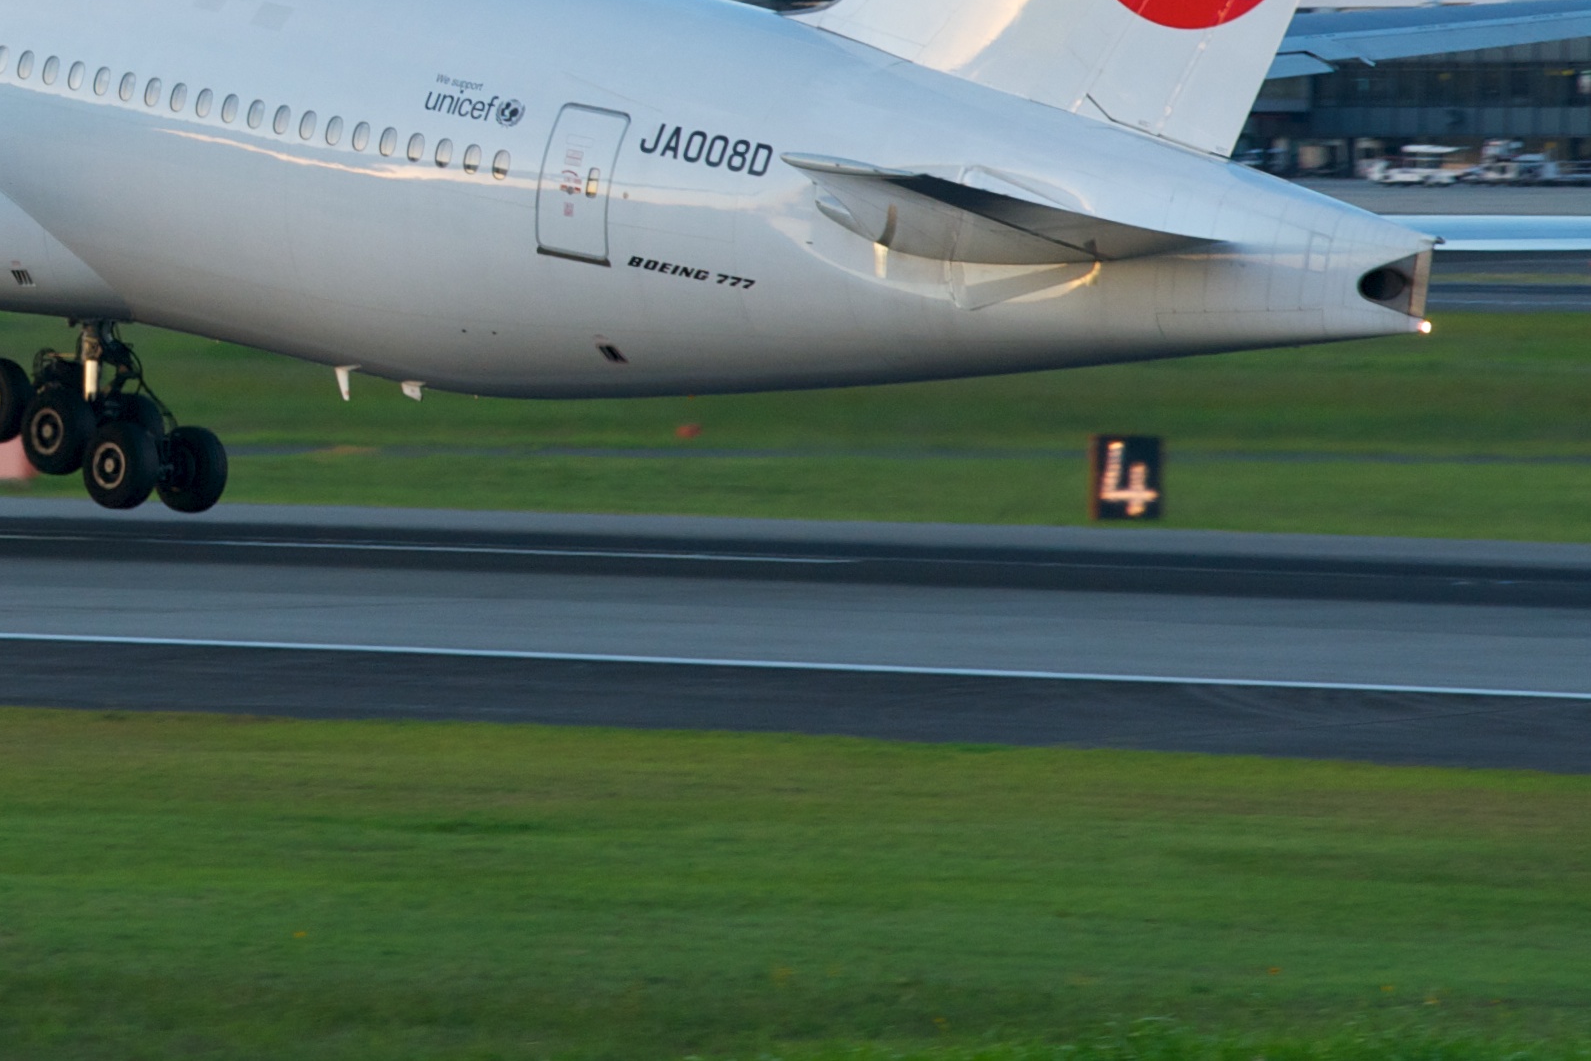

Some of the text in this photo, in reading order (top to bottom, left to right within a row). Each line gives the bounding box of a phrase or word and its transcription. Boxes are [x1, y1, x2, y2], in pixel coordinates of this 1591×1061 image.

[451, 78, 483, 91] support
[424, 89, 499, 121] unicef
[640, 123, 773, 177] JA008D
[627, 255, 756, 290] BOEING 777
[1099, 440, 1159, 516] 4
